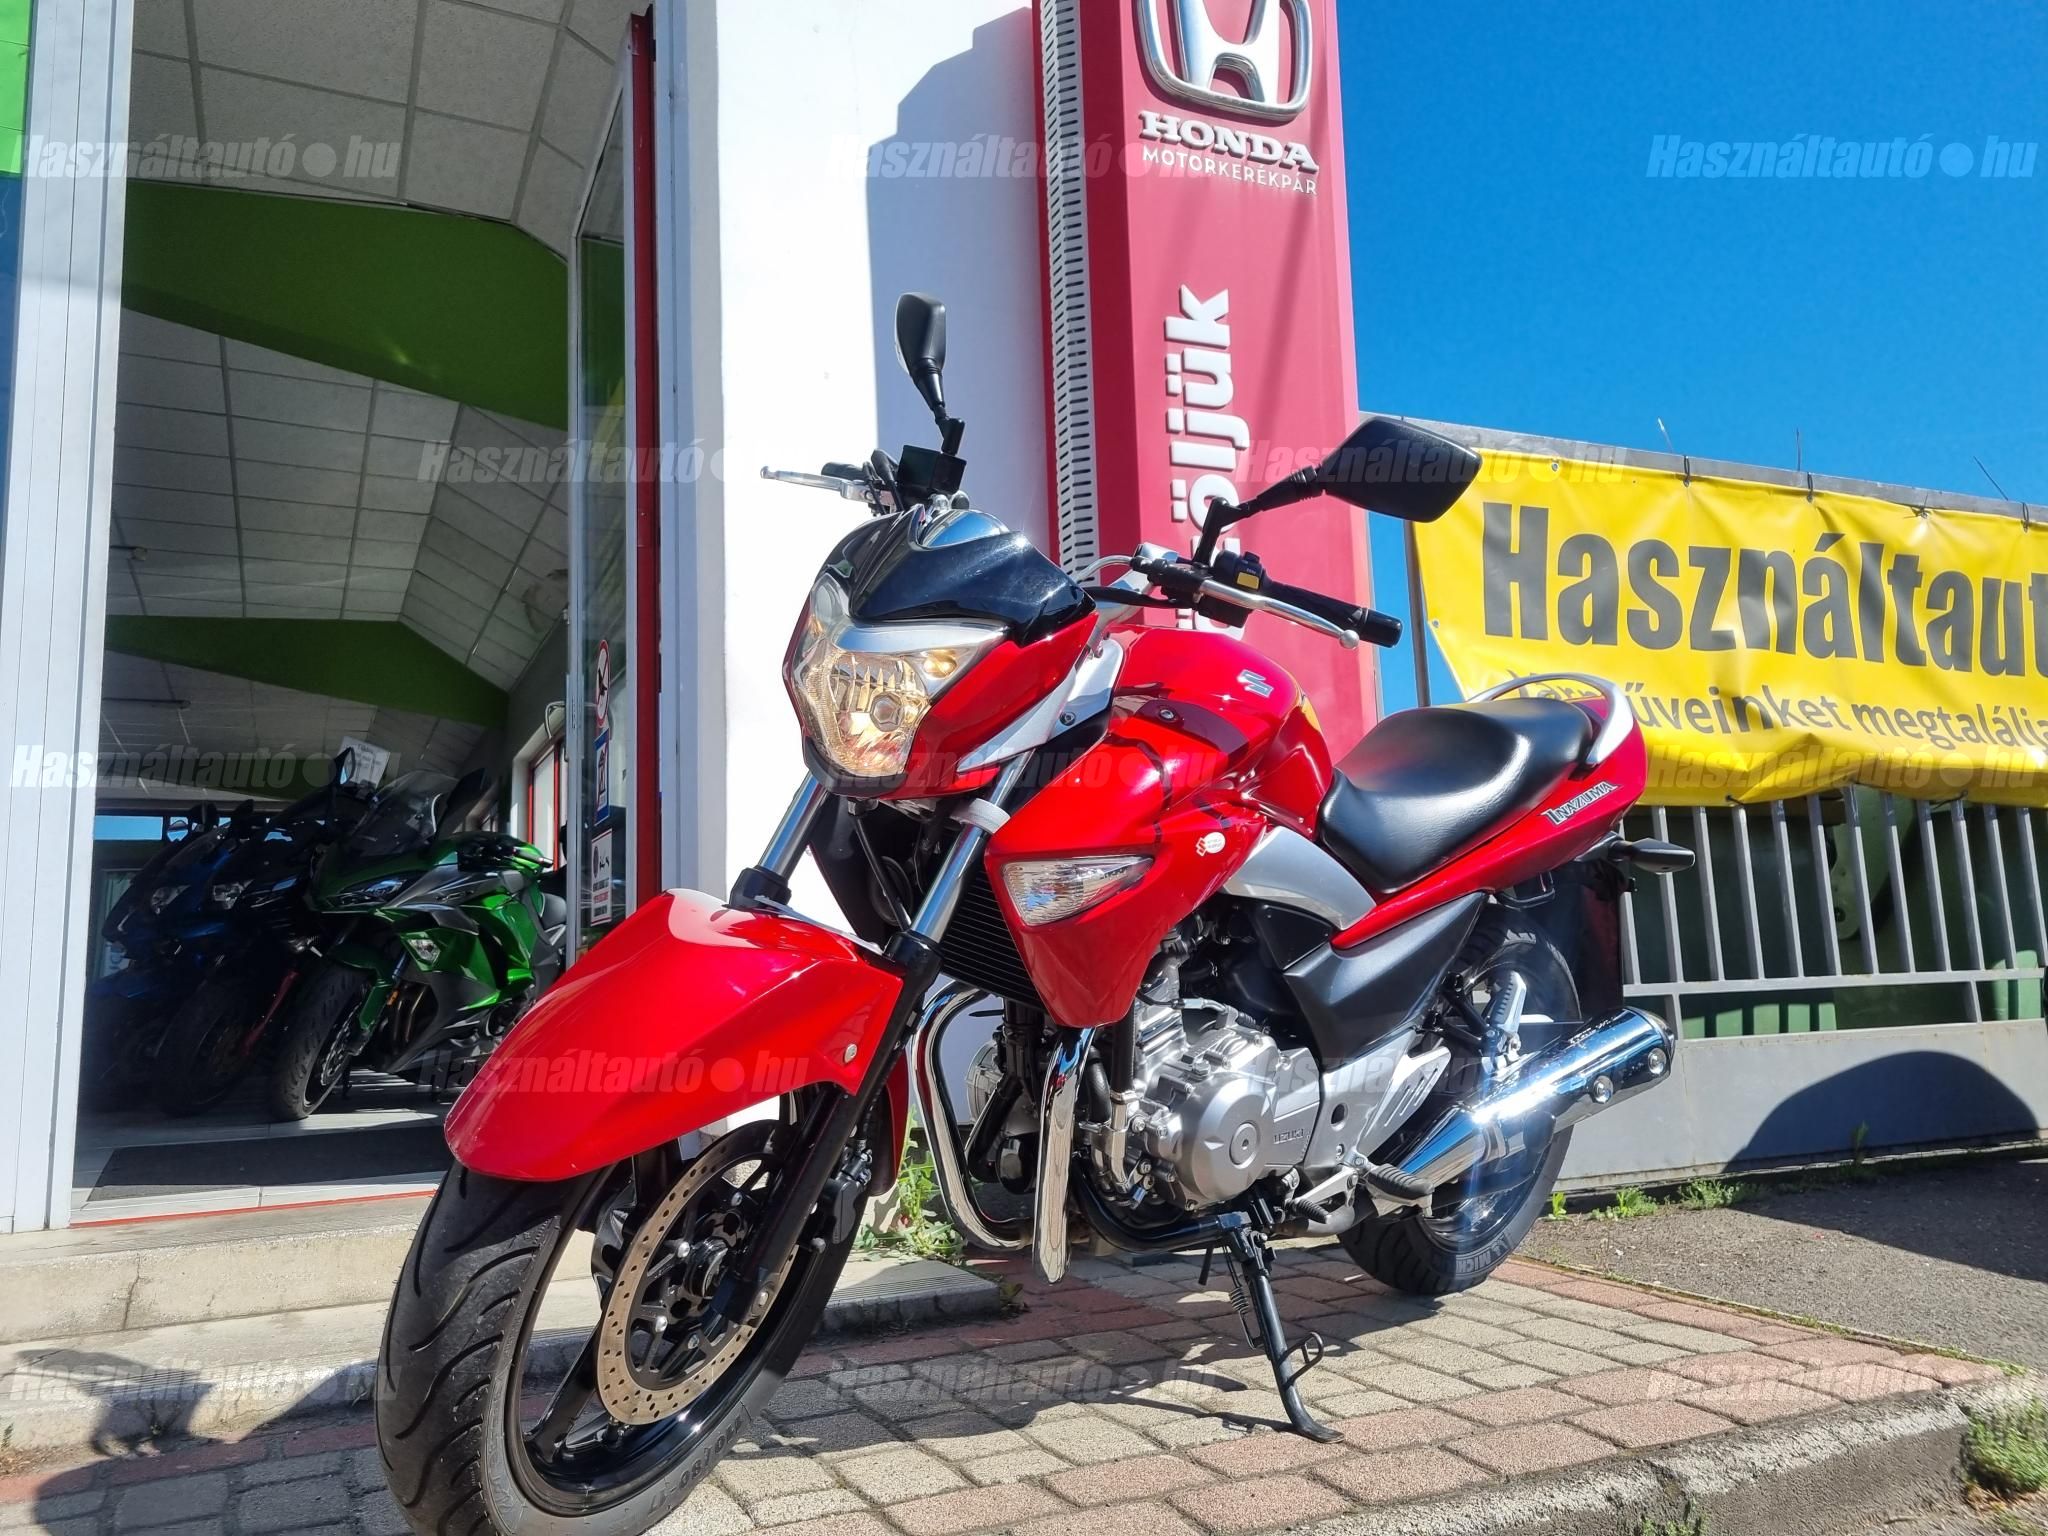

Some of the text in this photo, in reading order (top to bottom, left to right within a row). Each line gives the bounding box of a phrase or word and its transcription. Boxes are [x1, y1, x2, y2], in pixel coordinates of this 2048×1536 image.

[1139, 110, 1319, 173] HONDA
[1142, 144, 1317, 195] MOTORKERÉKPÁR
[1540, 781, 1619, 825] INAZUMA
